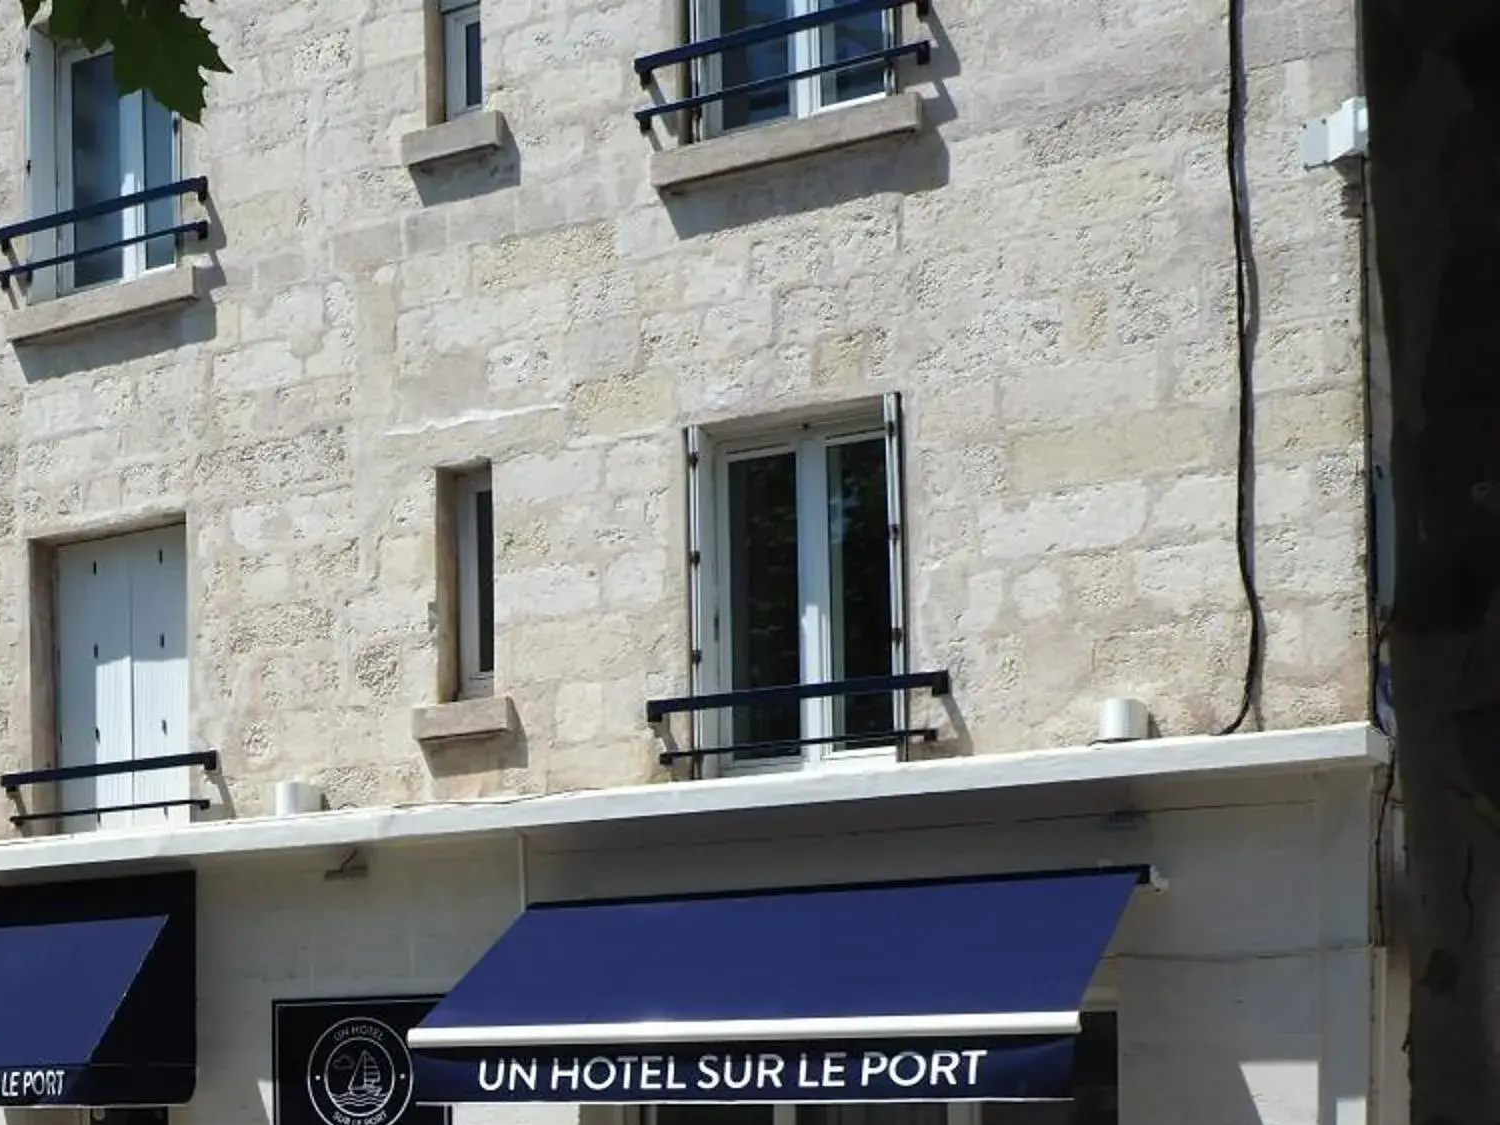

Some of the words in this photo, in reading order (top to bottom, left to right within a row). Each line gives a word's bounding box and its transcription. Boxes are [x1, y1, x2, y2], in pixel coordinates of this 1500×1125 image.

[351, 1025, 384, 1041] HOTEL
[2, 1071, 21, 1097] LE
[23, 1069, 66, 1097] PORT
[478, 1057, 537, 1092] UN
[550, 1055, 687, 1091] HOTEL
[697, 1053, 785, 1090] SUR
[798, 1051, 847, 1087] LE
[860, 1049, 988, 1087] PORT
